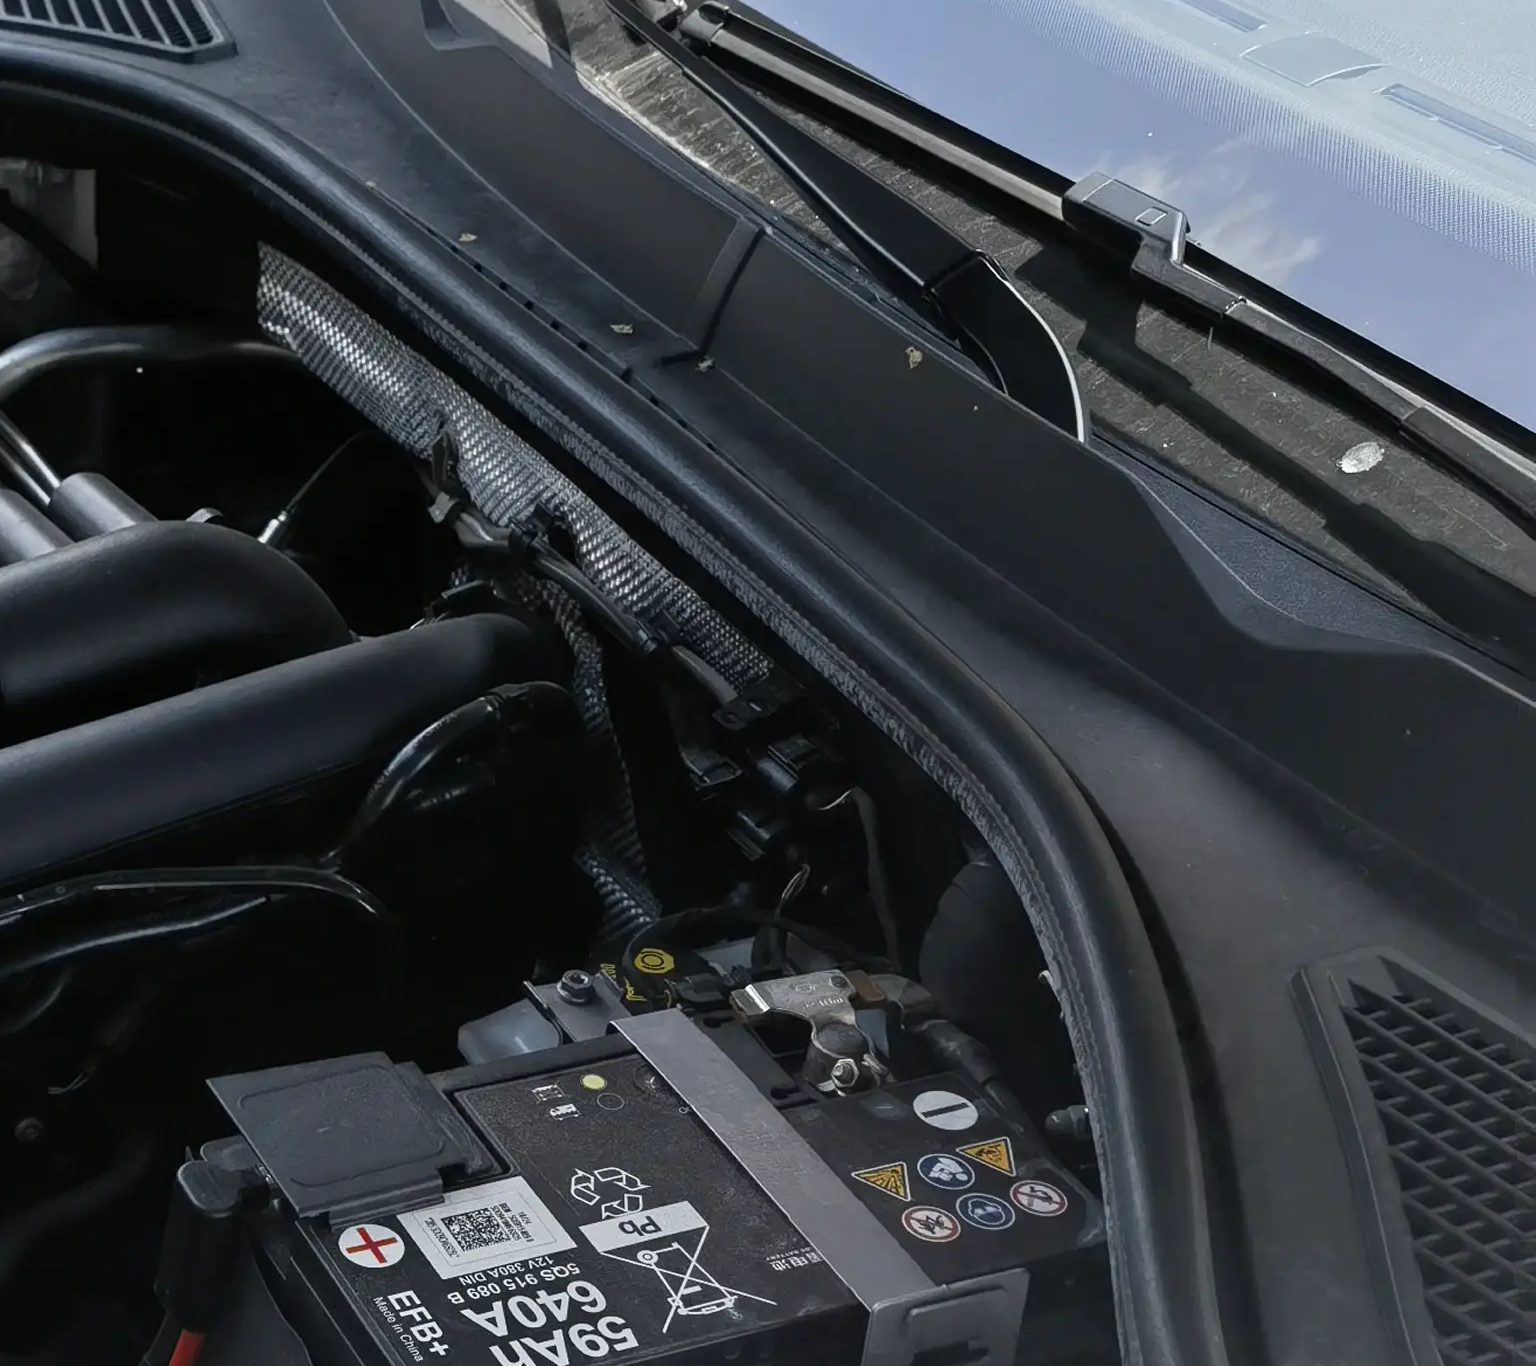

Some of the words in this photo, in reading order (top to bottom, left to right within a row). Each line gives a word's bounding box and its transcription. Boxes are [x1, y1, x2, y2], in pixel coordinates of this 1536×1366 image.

[618, 1215, 662, 1237] Pb
[489, 1261, 524, 1278] 380A
[527, 1256, 554, 1269] 12V
[543, 1262, 580, 1283] 5QS
[459, 1271, 487, 1287] DIN
[503, 1271, 538, 1291] 915
[447, 1292, 465, 1305] B
[469, 1282, 501, 1300] 089
[460, 1280, 607, 1337] 640A
[373, 1296, 396, 1323] Made
[392, 1322, 404, 1334] in
[400, 1333, 424, 1362] China
[387, 1290, 452, 1357] EFB+
